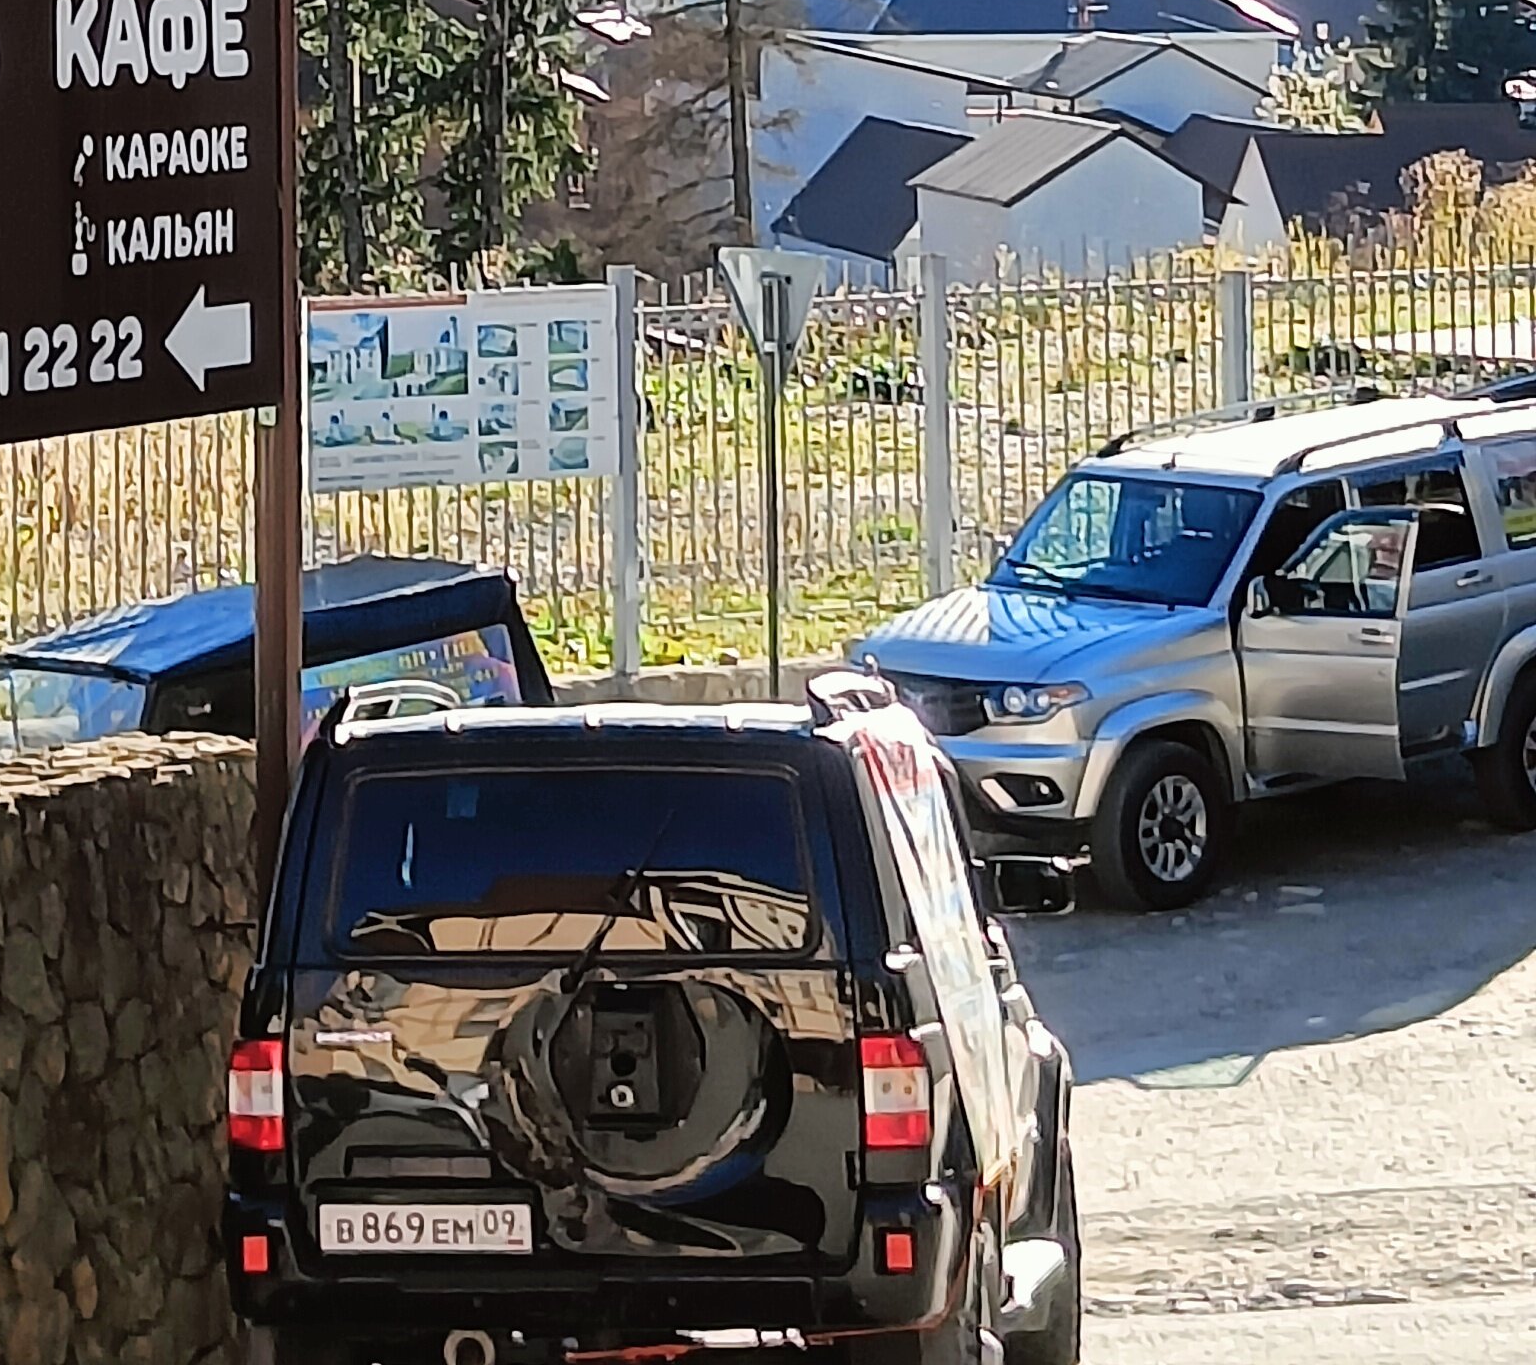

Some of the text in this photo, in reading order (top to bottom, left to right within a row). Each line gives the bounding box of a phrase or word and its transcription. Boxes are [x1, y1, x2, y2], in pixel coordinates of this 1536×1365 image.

[105, 125, 248, 182] КАРАОКЕ
[107, 207, 234, 266] КАЛЬЯН
[23, 323, 78, 392] 22
[89, 315, 143, 383] 22
